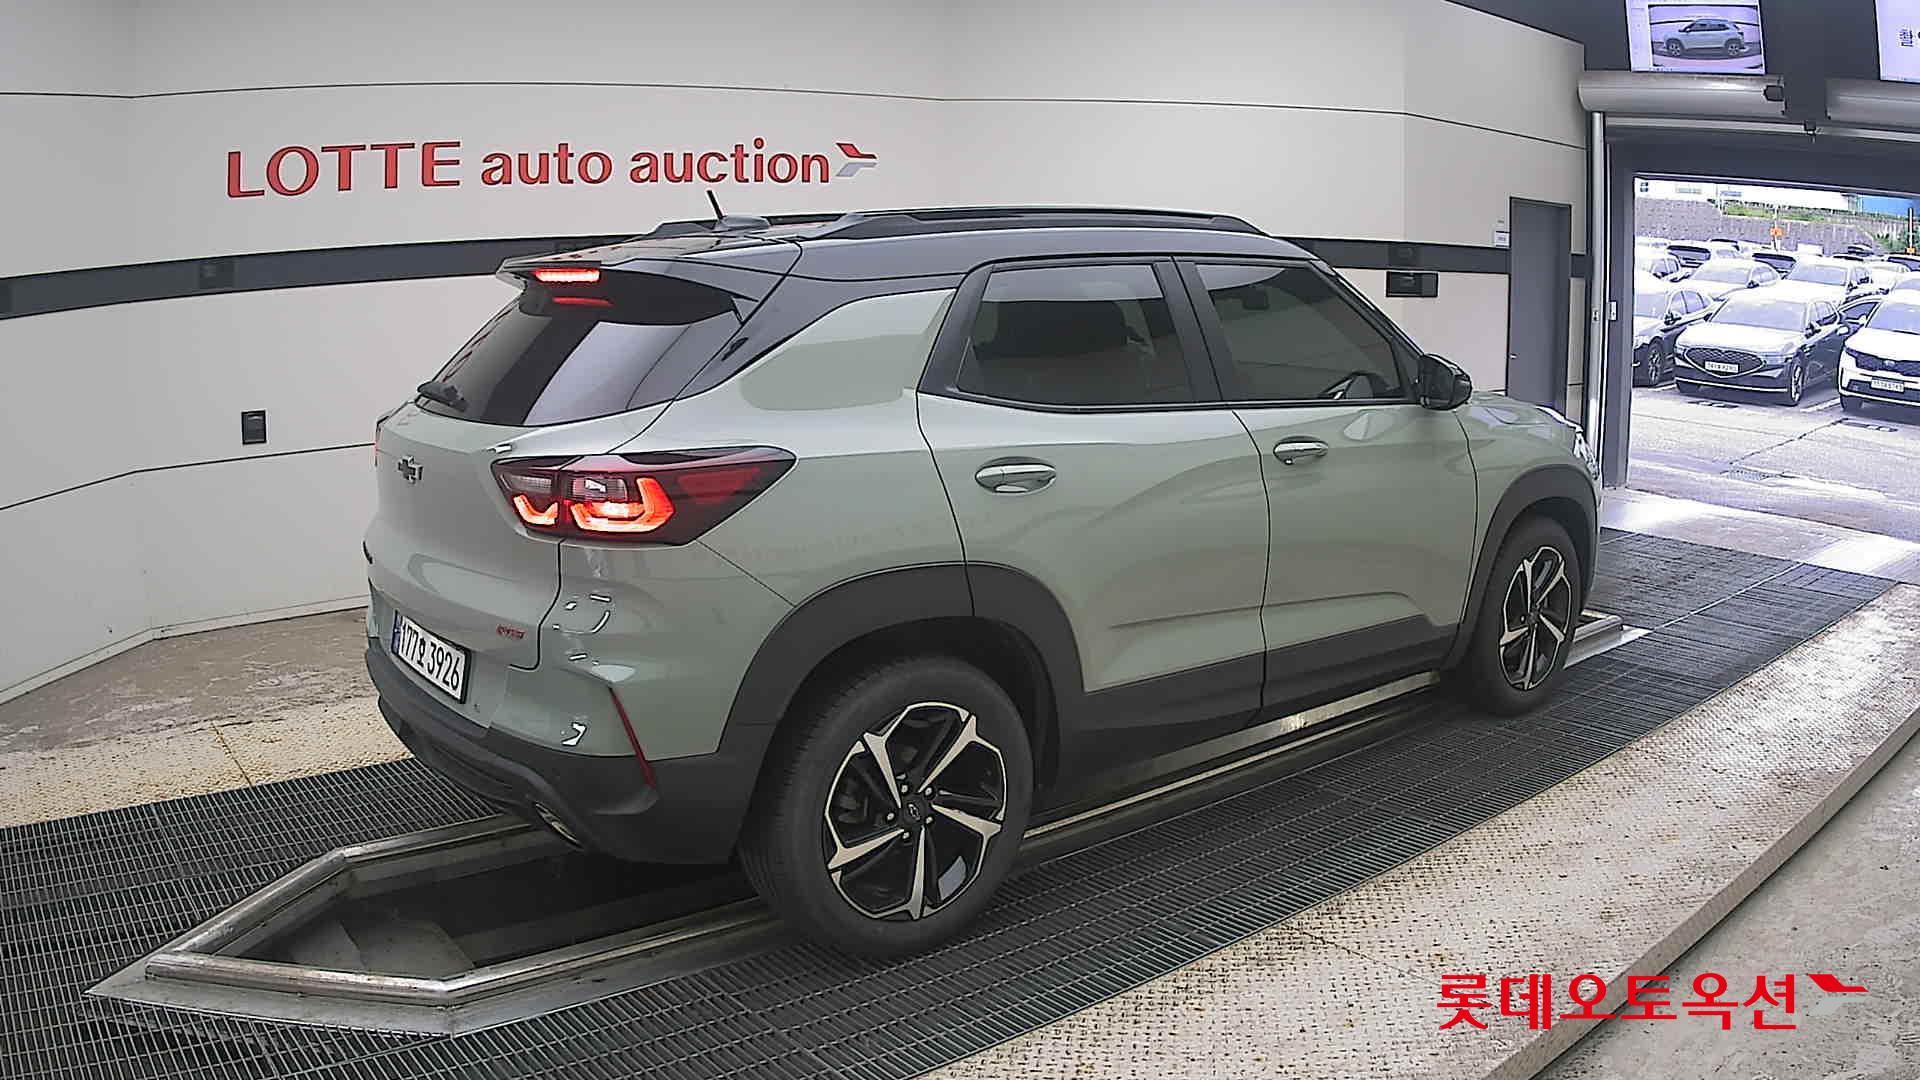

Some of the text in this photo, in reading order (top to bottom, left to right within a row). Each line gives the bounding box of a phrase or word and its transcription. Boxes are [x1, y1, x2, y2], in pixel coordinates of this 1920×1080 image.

[227, 137, 831, 198] LOTTE auto auction
[427, 641, 460, 690] 3926
